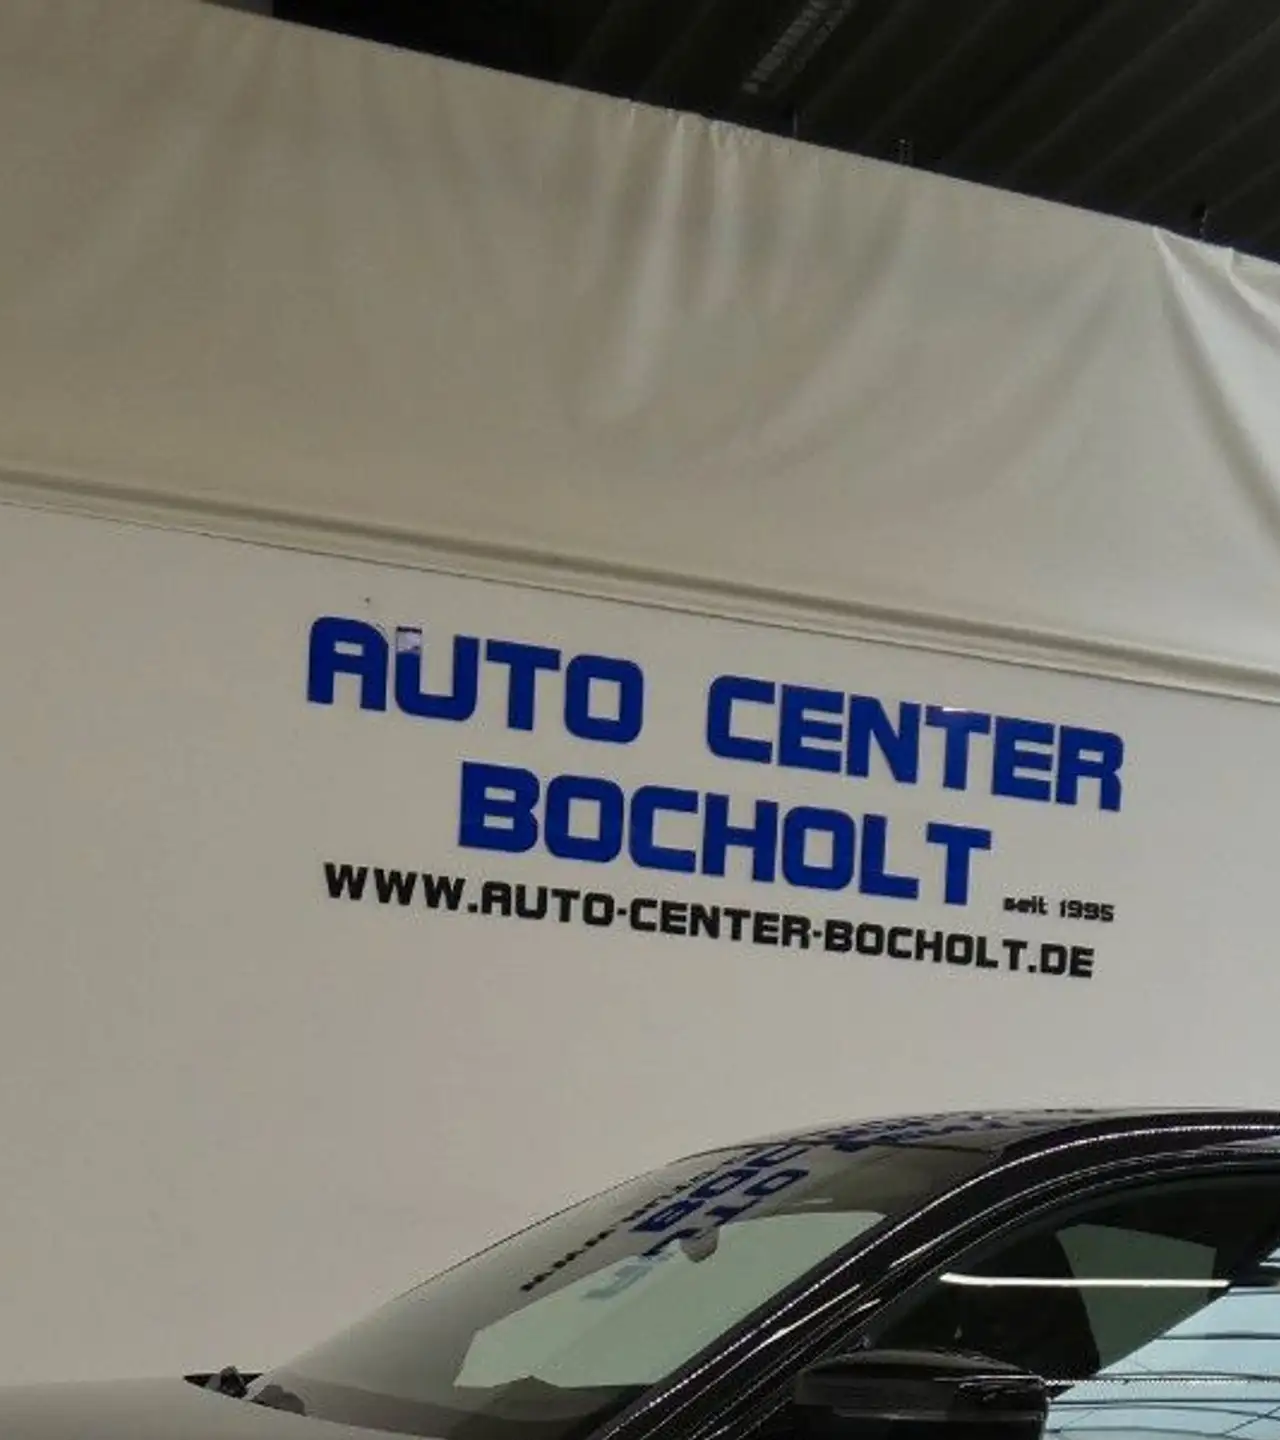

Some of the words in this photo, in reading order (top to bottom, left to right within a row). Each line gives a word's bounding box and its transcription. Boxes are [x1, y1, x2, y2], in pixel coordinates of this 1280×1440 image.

[307, 615, 645, 745] AUTO
[706, 675, 1125, 812] CENTER
[457, 761, 992, 907] BOCHOLT
[323, 861, 1096, 980] WWW.AUTO-CENTER-BOCHOLT.DE
[1002, 895, 1049, 916] seit
[1059, 899, 1115, 923] 1995
